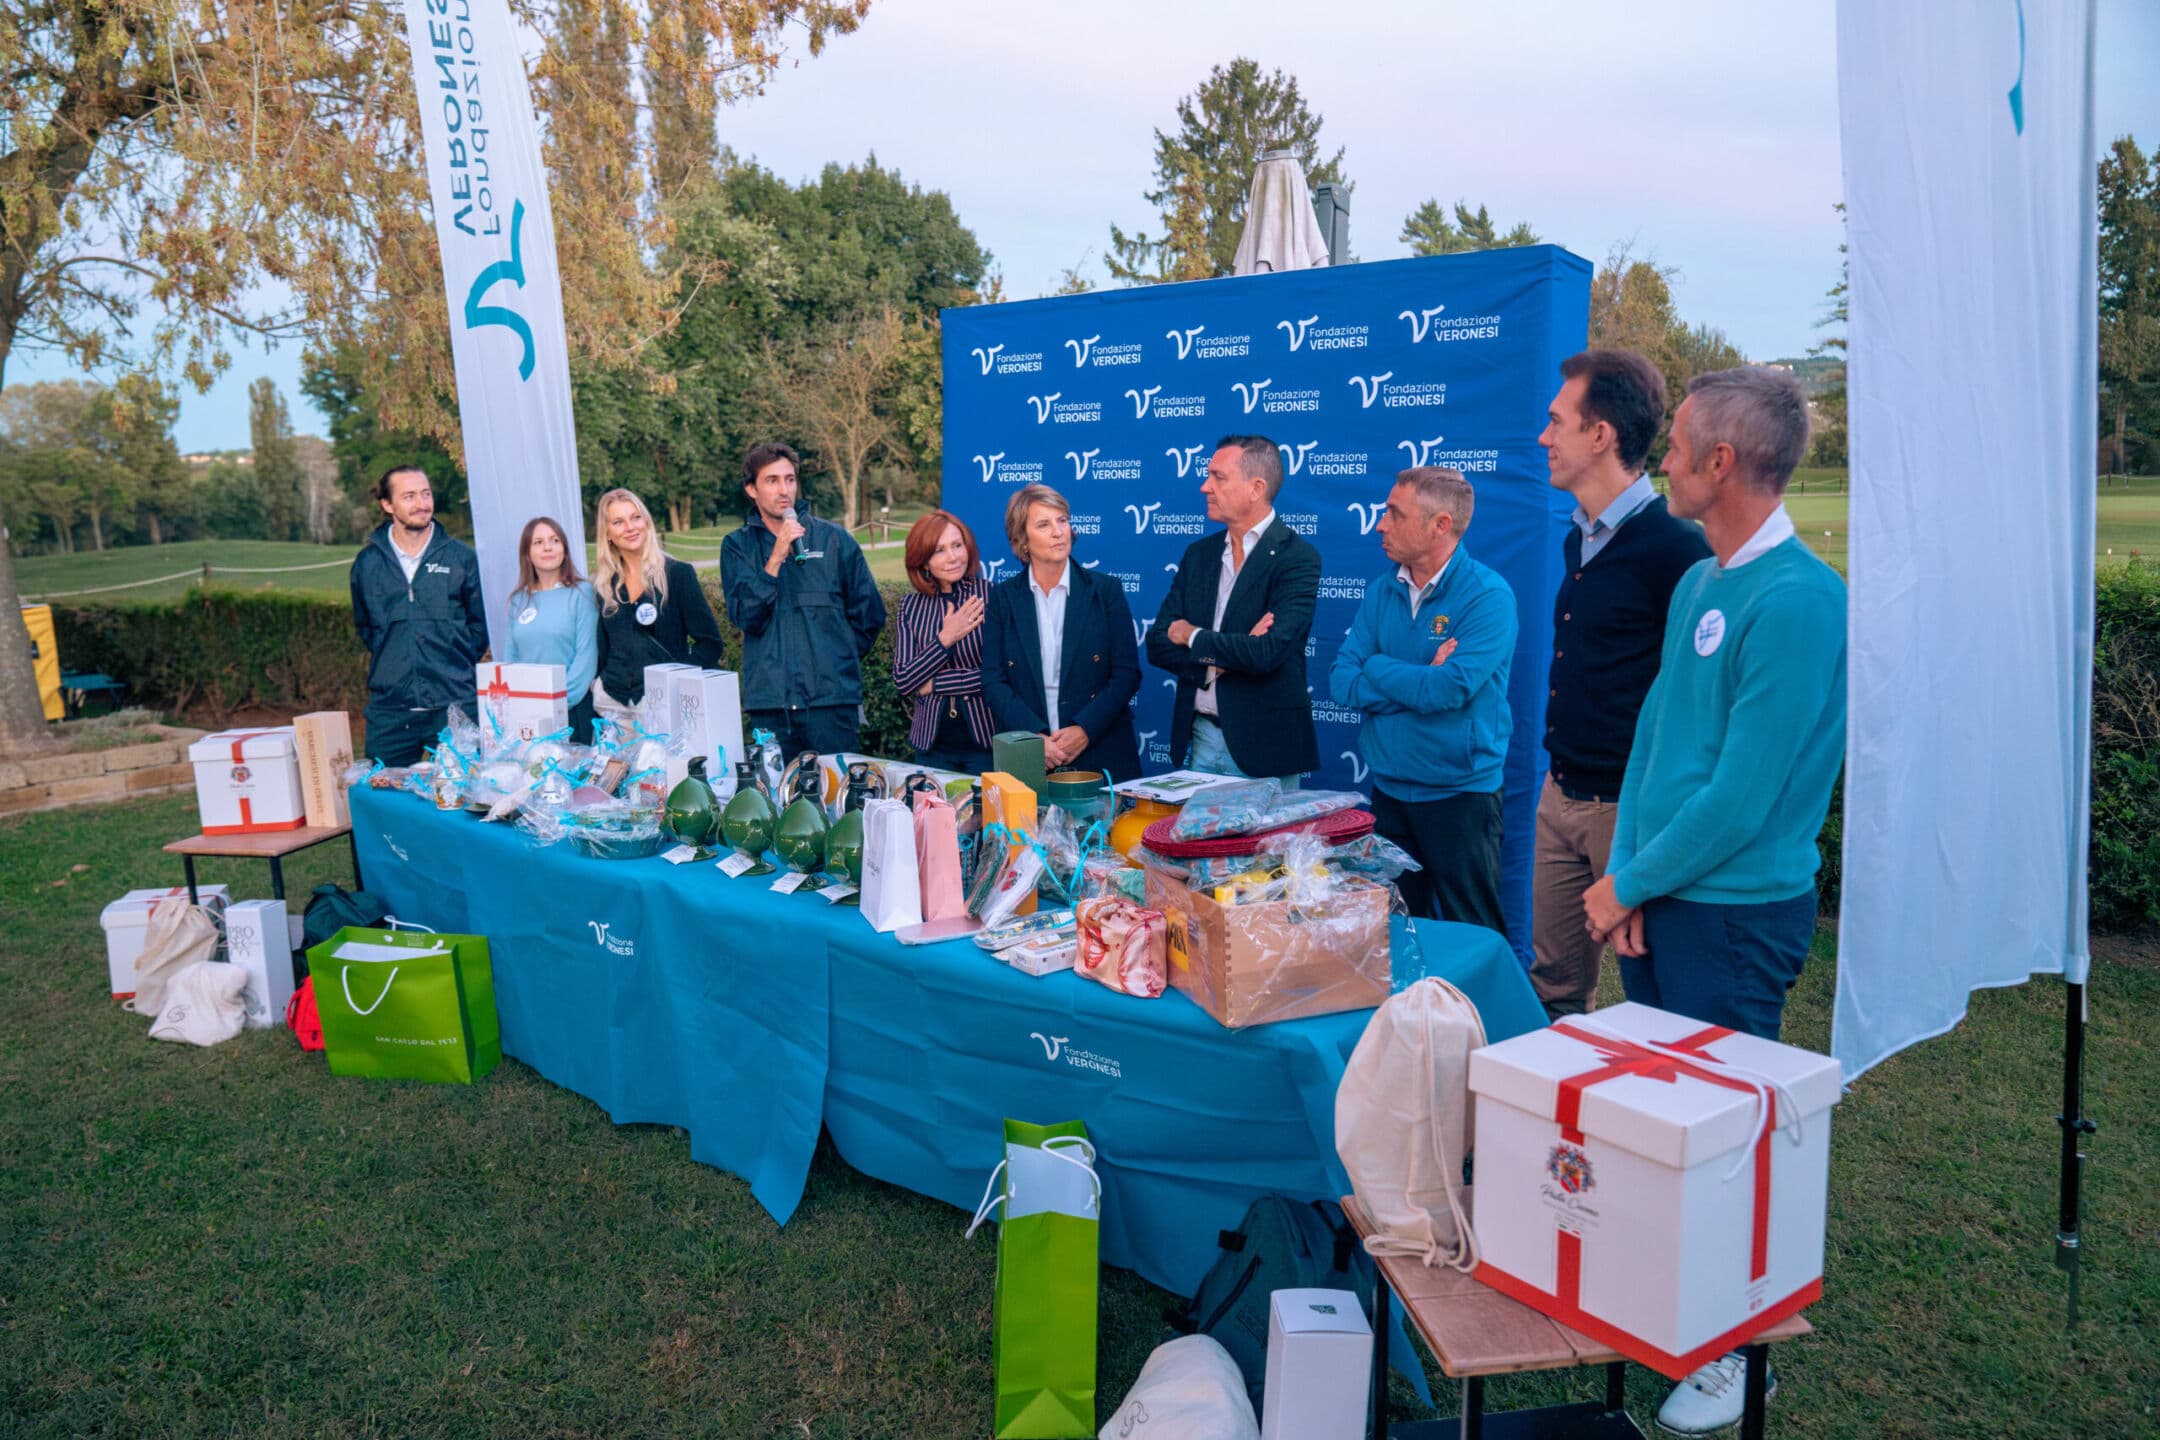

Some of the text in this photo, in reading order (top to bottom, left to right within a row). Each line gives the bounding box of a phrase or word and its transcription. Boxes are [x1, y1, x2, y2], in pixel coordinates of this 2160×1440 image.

[1434, 315, 1501, 328] Fondazione
[1309, 324, 1369, 337] Fondazione
[1434, 326, 1499, 342] VERONESI
[1196, 334, 1250, 346] Fondazione
[1310, 336, 1368, 350] VERONESI
[1092, 344, 1142, 356] Fondazione
[1196, 345, 1249, 359] VERONESI
[996, 352, 1043, 364] Fondazione
[1092, 354, 1141, 367] VERONESI
[997, 362, 1042, 374] VERONESI
[1383, 382, 1447, 394] Fondazione
[1154, 394, 1206, 406] Fondazione
[1263, 389, 1320, 400] Fondazione
[1054, 401, 1102, 412] Fondazione
[1264, 400, 1319, 413] VERONESI
[1384, 394, 1445, 408] VERONESI
[1054, 411, 1100, 424] VERONESI
[1154, 405, 1205, 419] VERONESI
[1308, 452, 1368, 462] Fondazione
[1434, 448, 1498, 460] Fondazione
[998, 461, 1043, 471] Fondazione
[1092, 458, 1142, 469] Fondazione
[1092, 468, 1140, 480] VERONESI
[1309, 464, 1367, 476] VERONESI
[998, 471, 1042, 482] VERONESI
[1153, 513, 1205, 523] Fondazione
[1280, 513, 1318, 523] dazione
[1072, 524, 1100, 534] ONESI
[1153, 524, 1204, 534] VERONESI
[1319, 576, 1366, 587] ndazione
[1317, 587, 1364, 599] ERONESI
[1312, 710, 1361, 724] ERONESI
[1064, 1046, 1120, 1068] Fondazione
[1066, 1056, 1122, 1078] VERONESI
